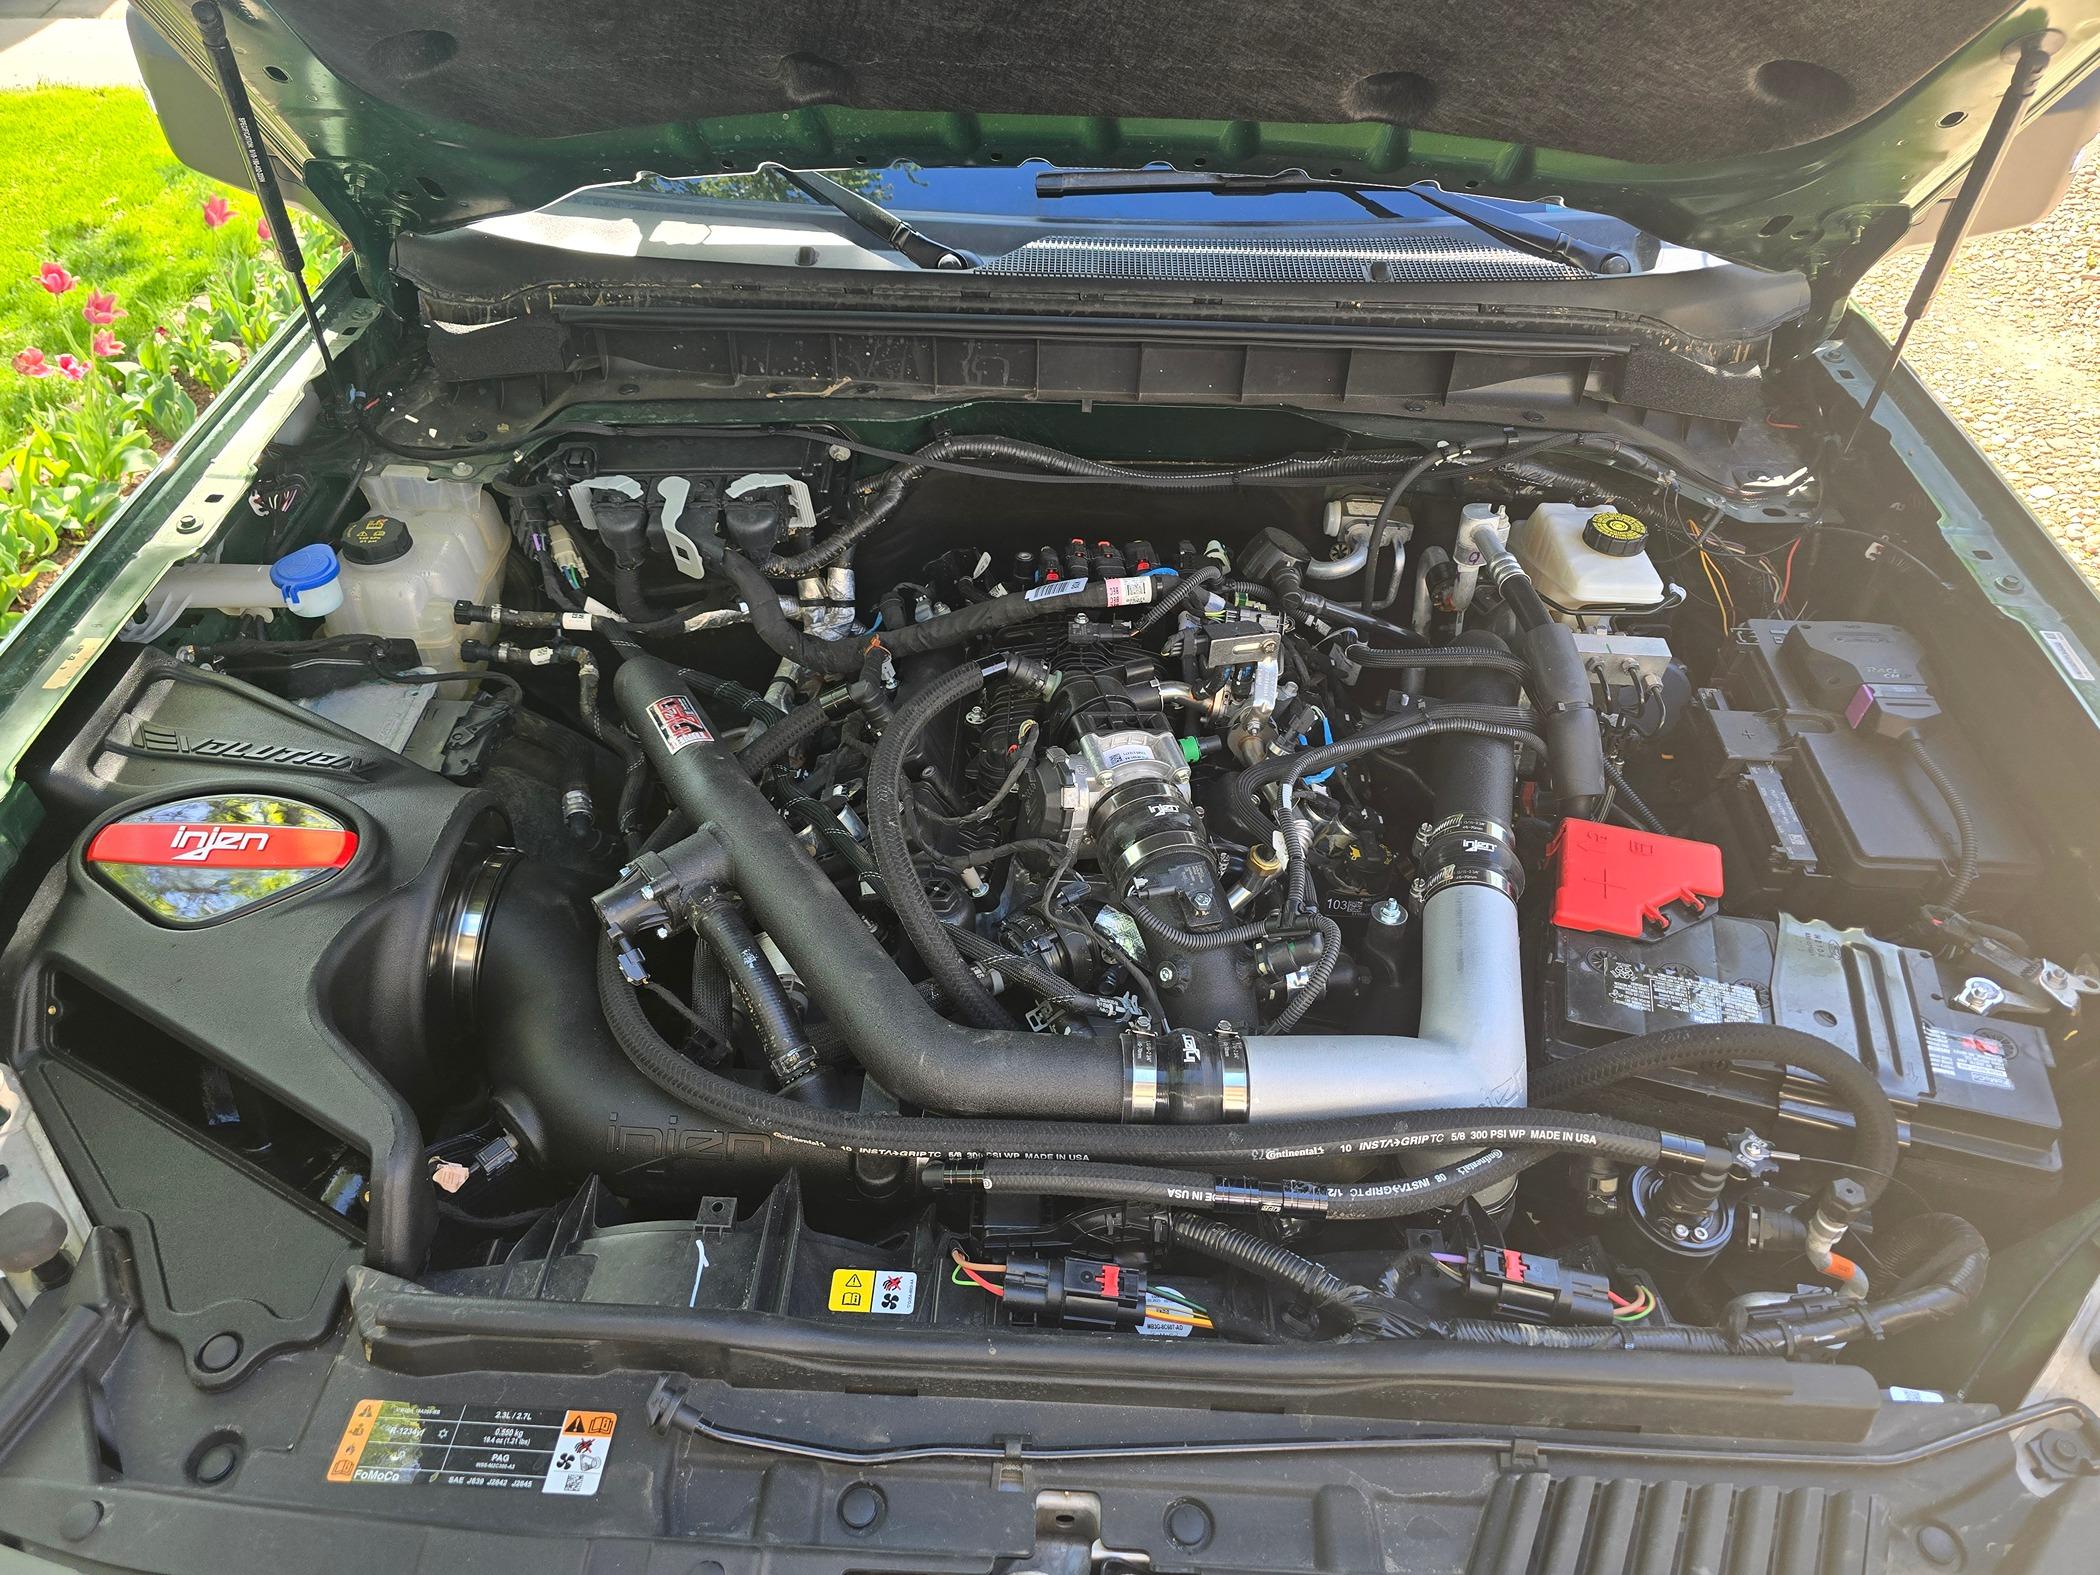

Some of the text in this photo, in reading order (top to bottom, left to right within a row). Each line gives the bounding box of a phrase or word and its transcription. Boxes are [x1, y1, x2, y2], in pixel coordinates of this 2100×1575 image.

[170, 825, 269, 861] injen
[1327, 898, 1348, 911] 103
[1340, 1143, 1352, 1154] 10
[1450, 1131, 1466, 1142] 5/8
[1470, 1130, 1489, 1141] 300
[1489, 1129, 1507, 1140] PSI
[1508, 1129, 1526, 1139] WP
[1529, 1129, 1561, 1141] MADE
[1562, 1131, 1574, 1142] IN
[1574, 1132, 1597, 1145] USA
[1002, 1152, 1021, 1160] WP
[1024, 1153, 1054, 1161] MADE
[1055, 1153, 1066, 1161] IN
[1067, 1153, 1091, 1162] USA
[1166, 1187, 1190, 1200] USA
[1191, 1191, 1203, 1201] IN
[1327, 1187, 1343, 1198] 1/2
[494, 1411, 511, 1420] 2.3L
[517, 1412, 532, 1421] 2.7L
[514, 1429, 524, 1438] kg
[491, 1453, 510, 1462] PAG
[353, 1469, 401, 1480] FoMoCo
[448, 1476, 465, 1484] SAE
